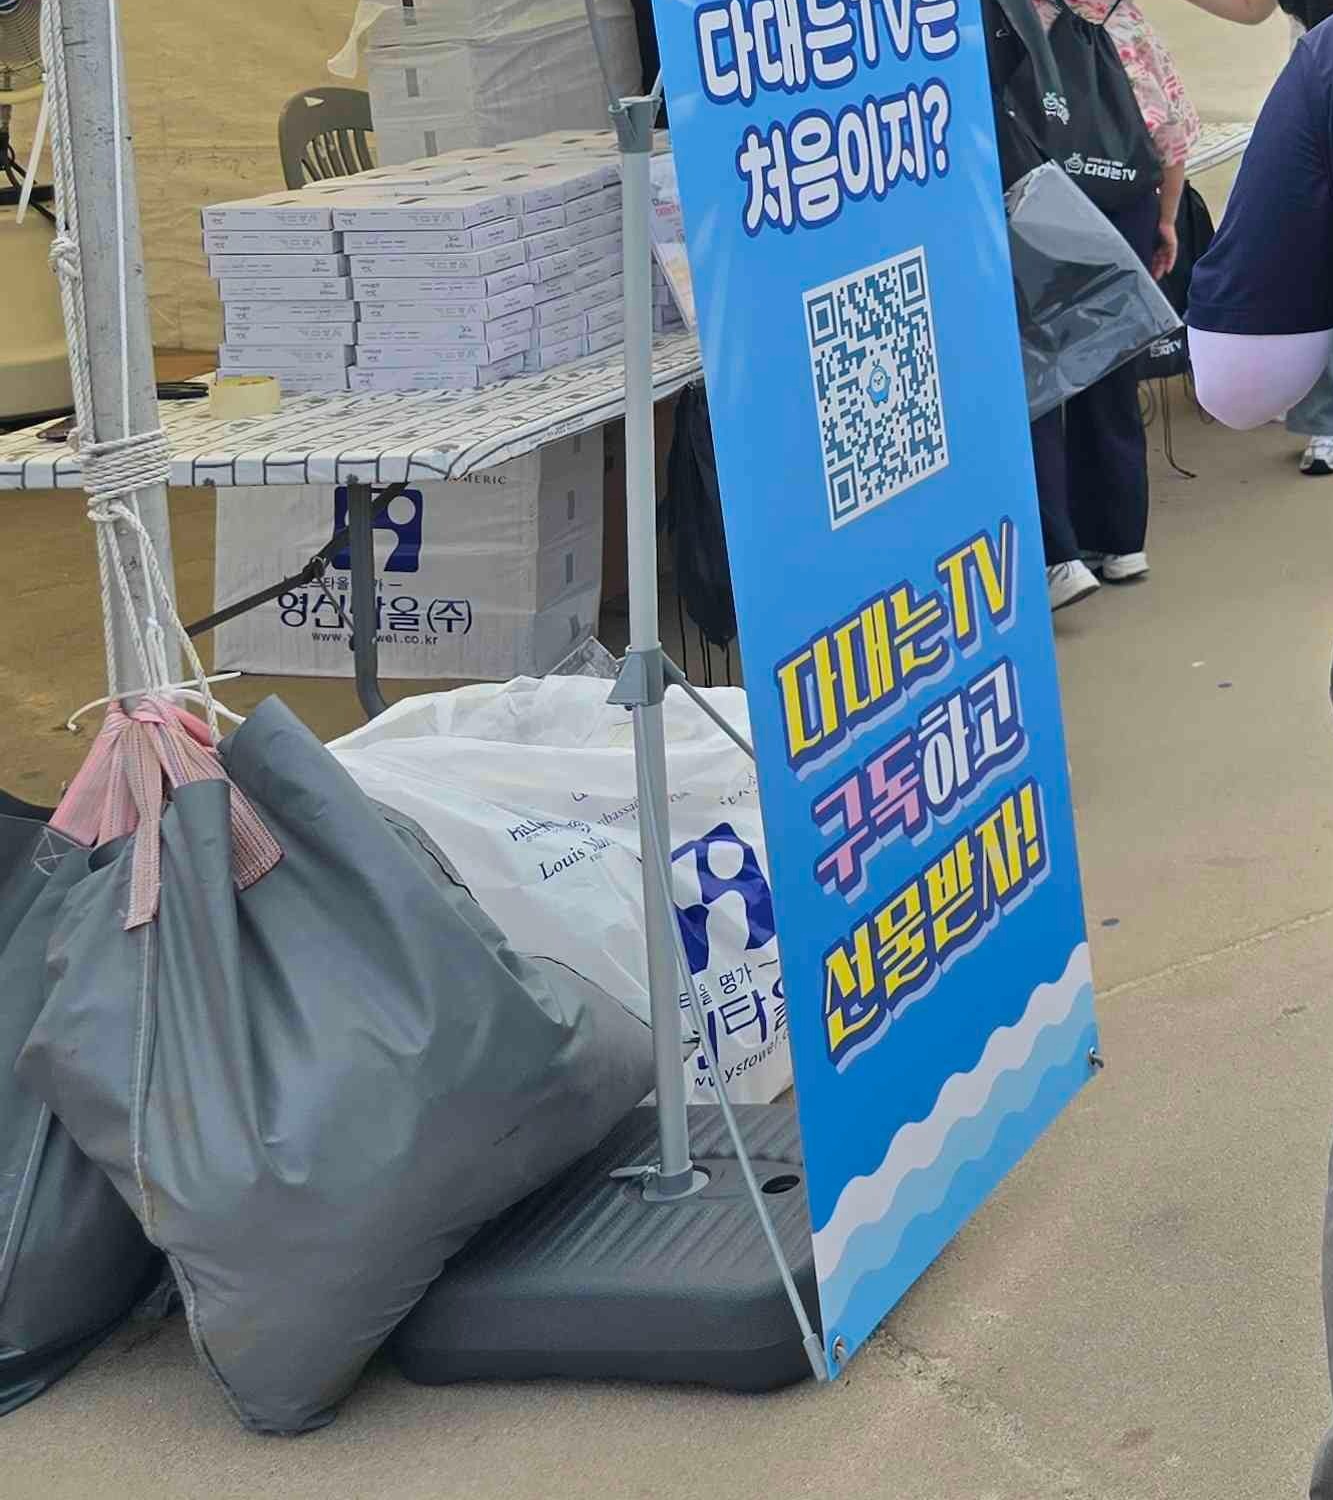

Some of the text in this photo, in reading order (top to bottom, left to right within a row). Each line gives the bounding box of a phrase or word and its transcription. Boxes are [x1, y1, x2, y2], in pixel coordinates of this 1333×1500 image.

[740, 83, 951, 231] 처음이지?
[776, 517, 1016, 764] 다대는TV
[537, 846, 586, 882] Louis
[811, 660, 1020, 889] 구독하고
[823, 779, 1046, 1057] 선물받자!
